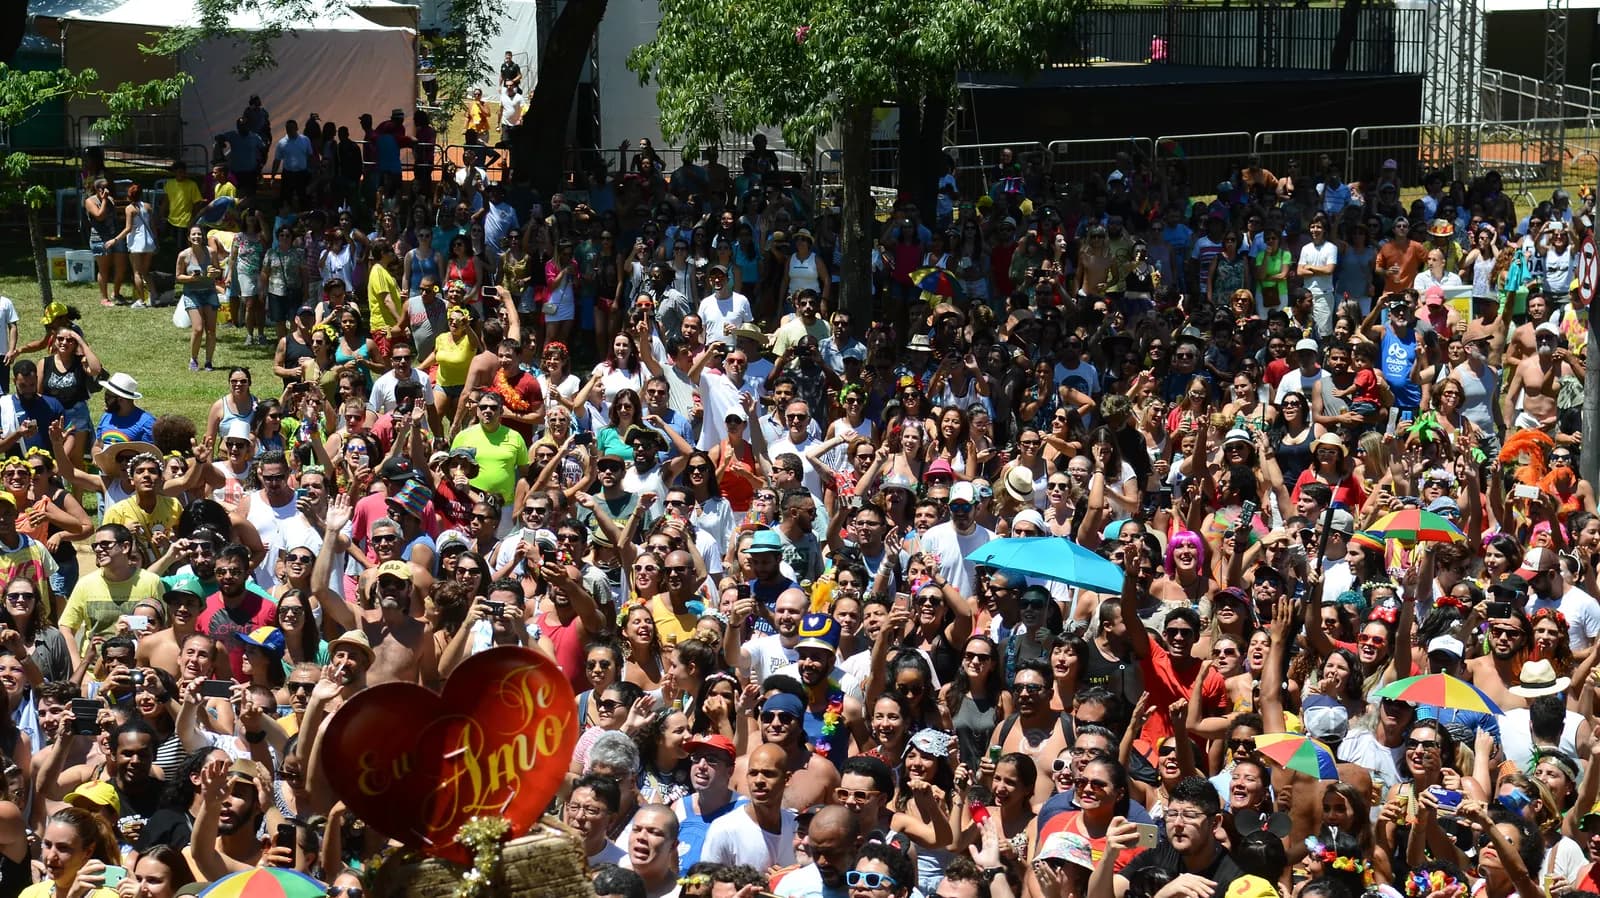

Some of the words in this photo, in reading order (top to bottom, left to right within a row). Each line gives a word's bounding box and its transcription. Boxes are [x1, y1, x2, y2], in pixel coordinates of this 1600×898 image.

[496, 663, 555, 735] Te
[358, 751, 412, 796] Eu
[420, 712, 571, 831] Amo
